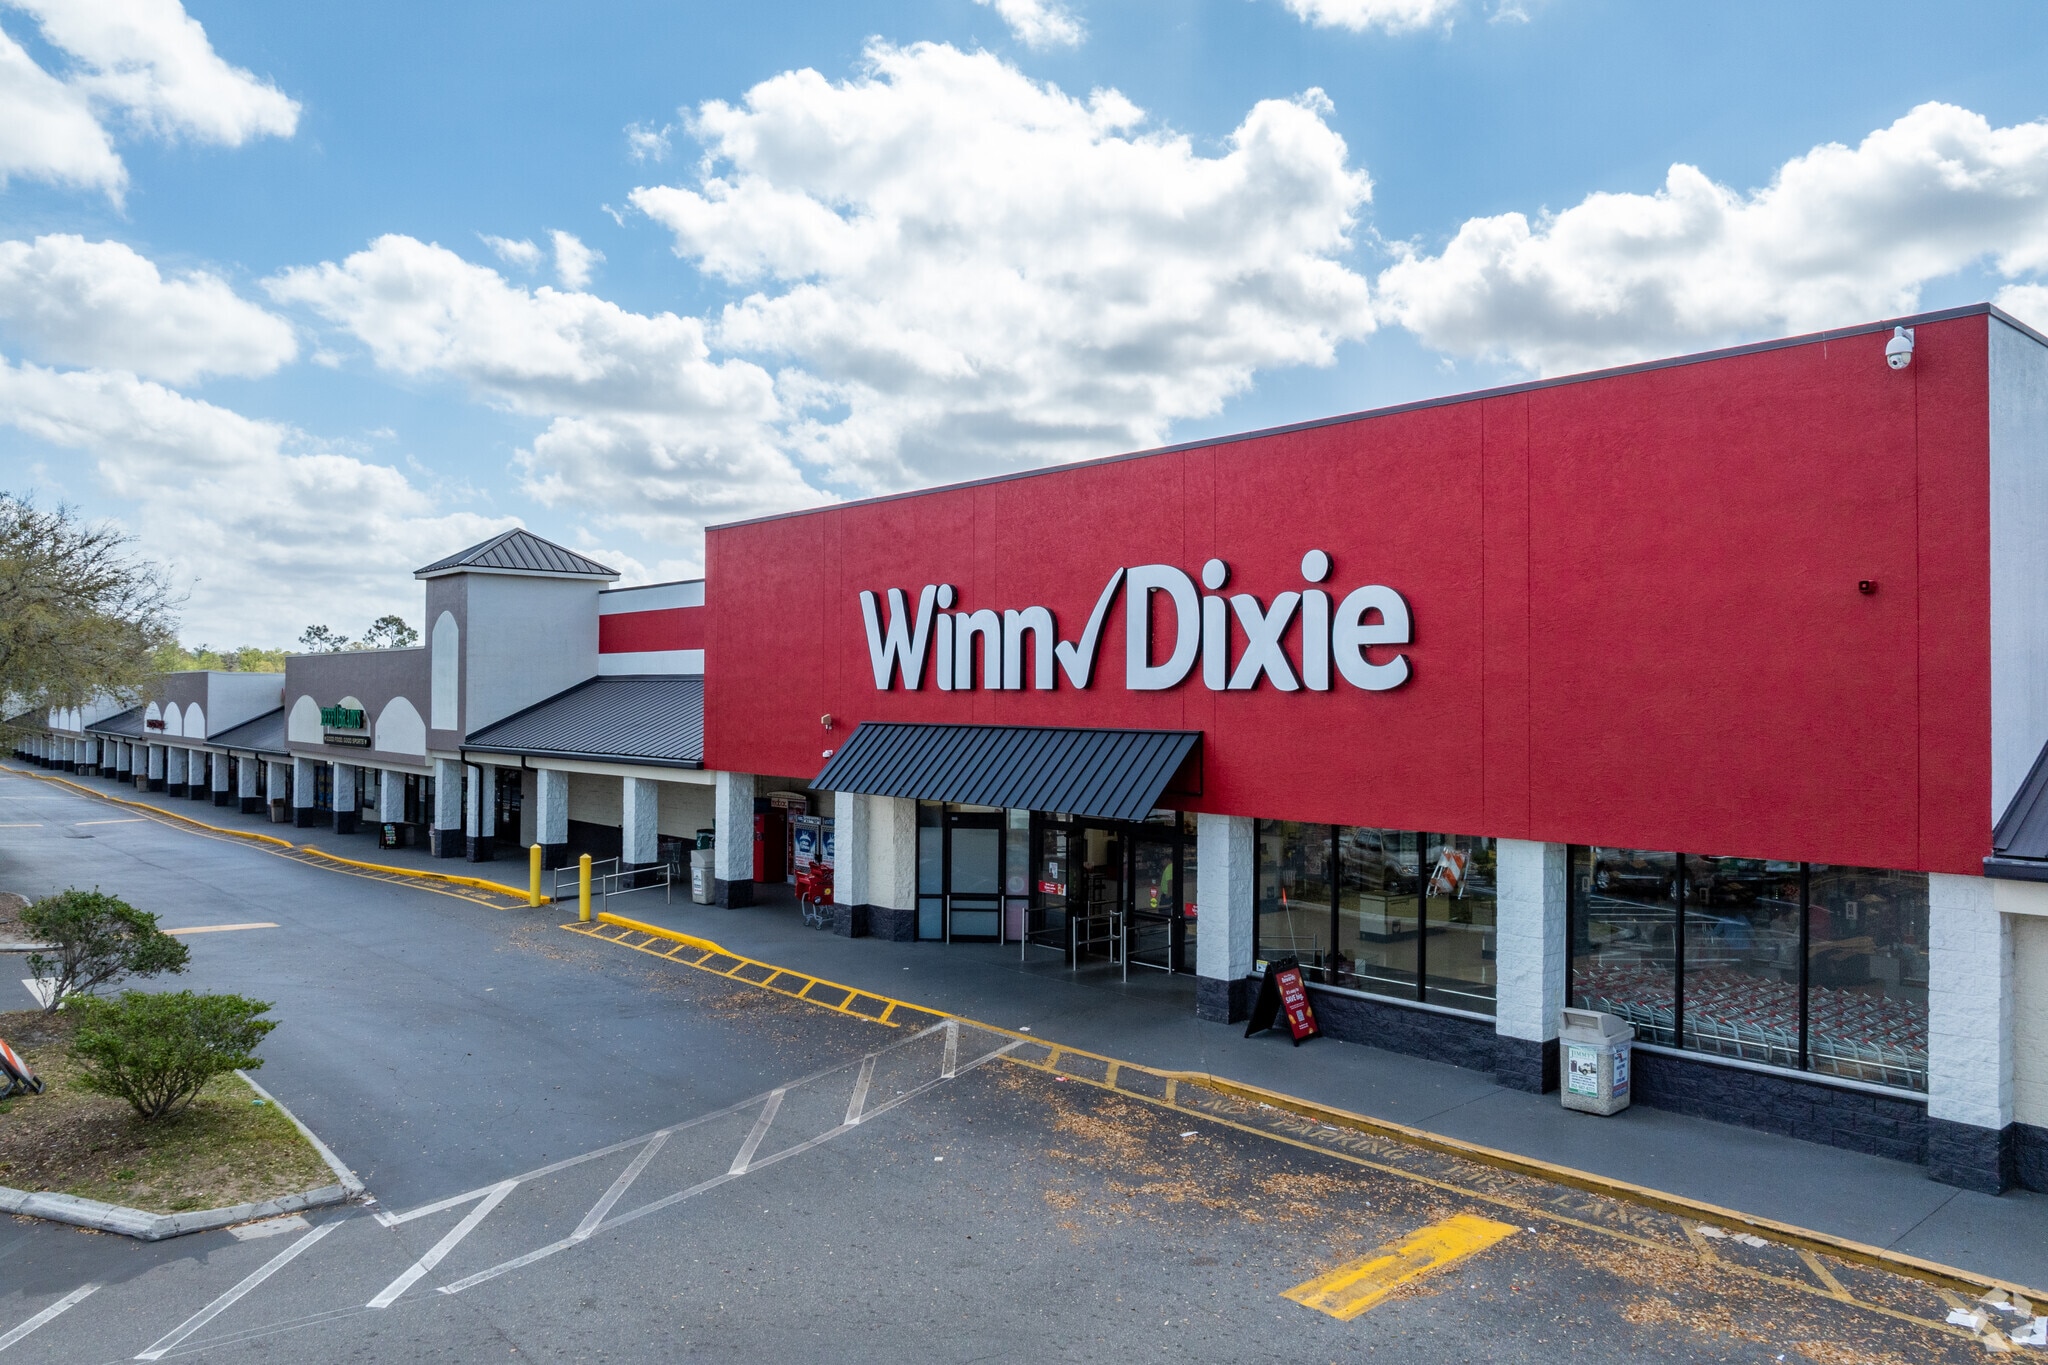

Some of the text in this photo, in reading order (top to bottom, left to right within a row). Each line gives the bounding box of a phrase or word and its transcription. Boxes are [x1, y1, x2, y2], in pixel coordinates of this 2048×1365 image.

[859, 549, 1411, 692] Winn Dixie
[1286, 995, 1296, 1004] SAVE
[1268, 1121, 1411, 1160] PARKING
